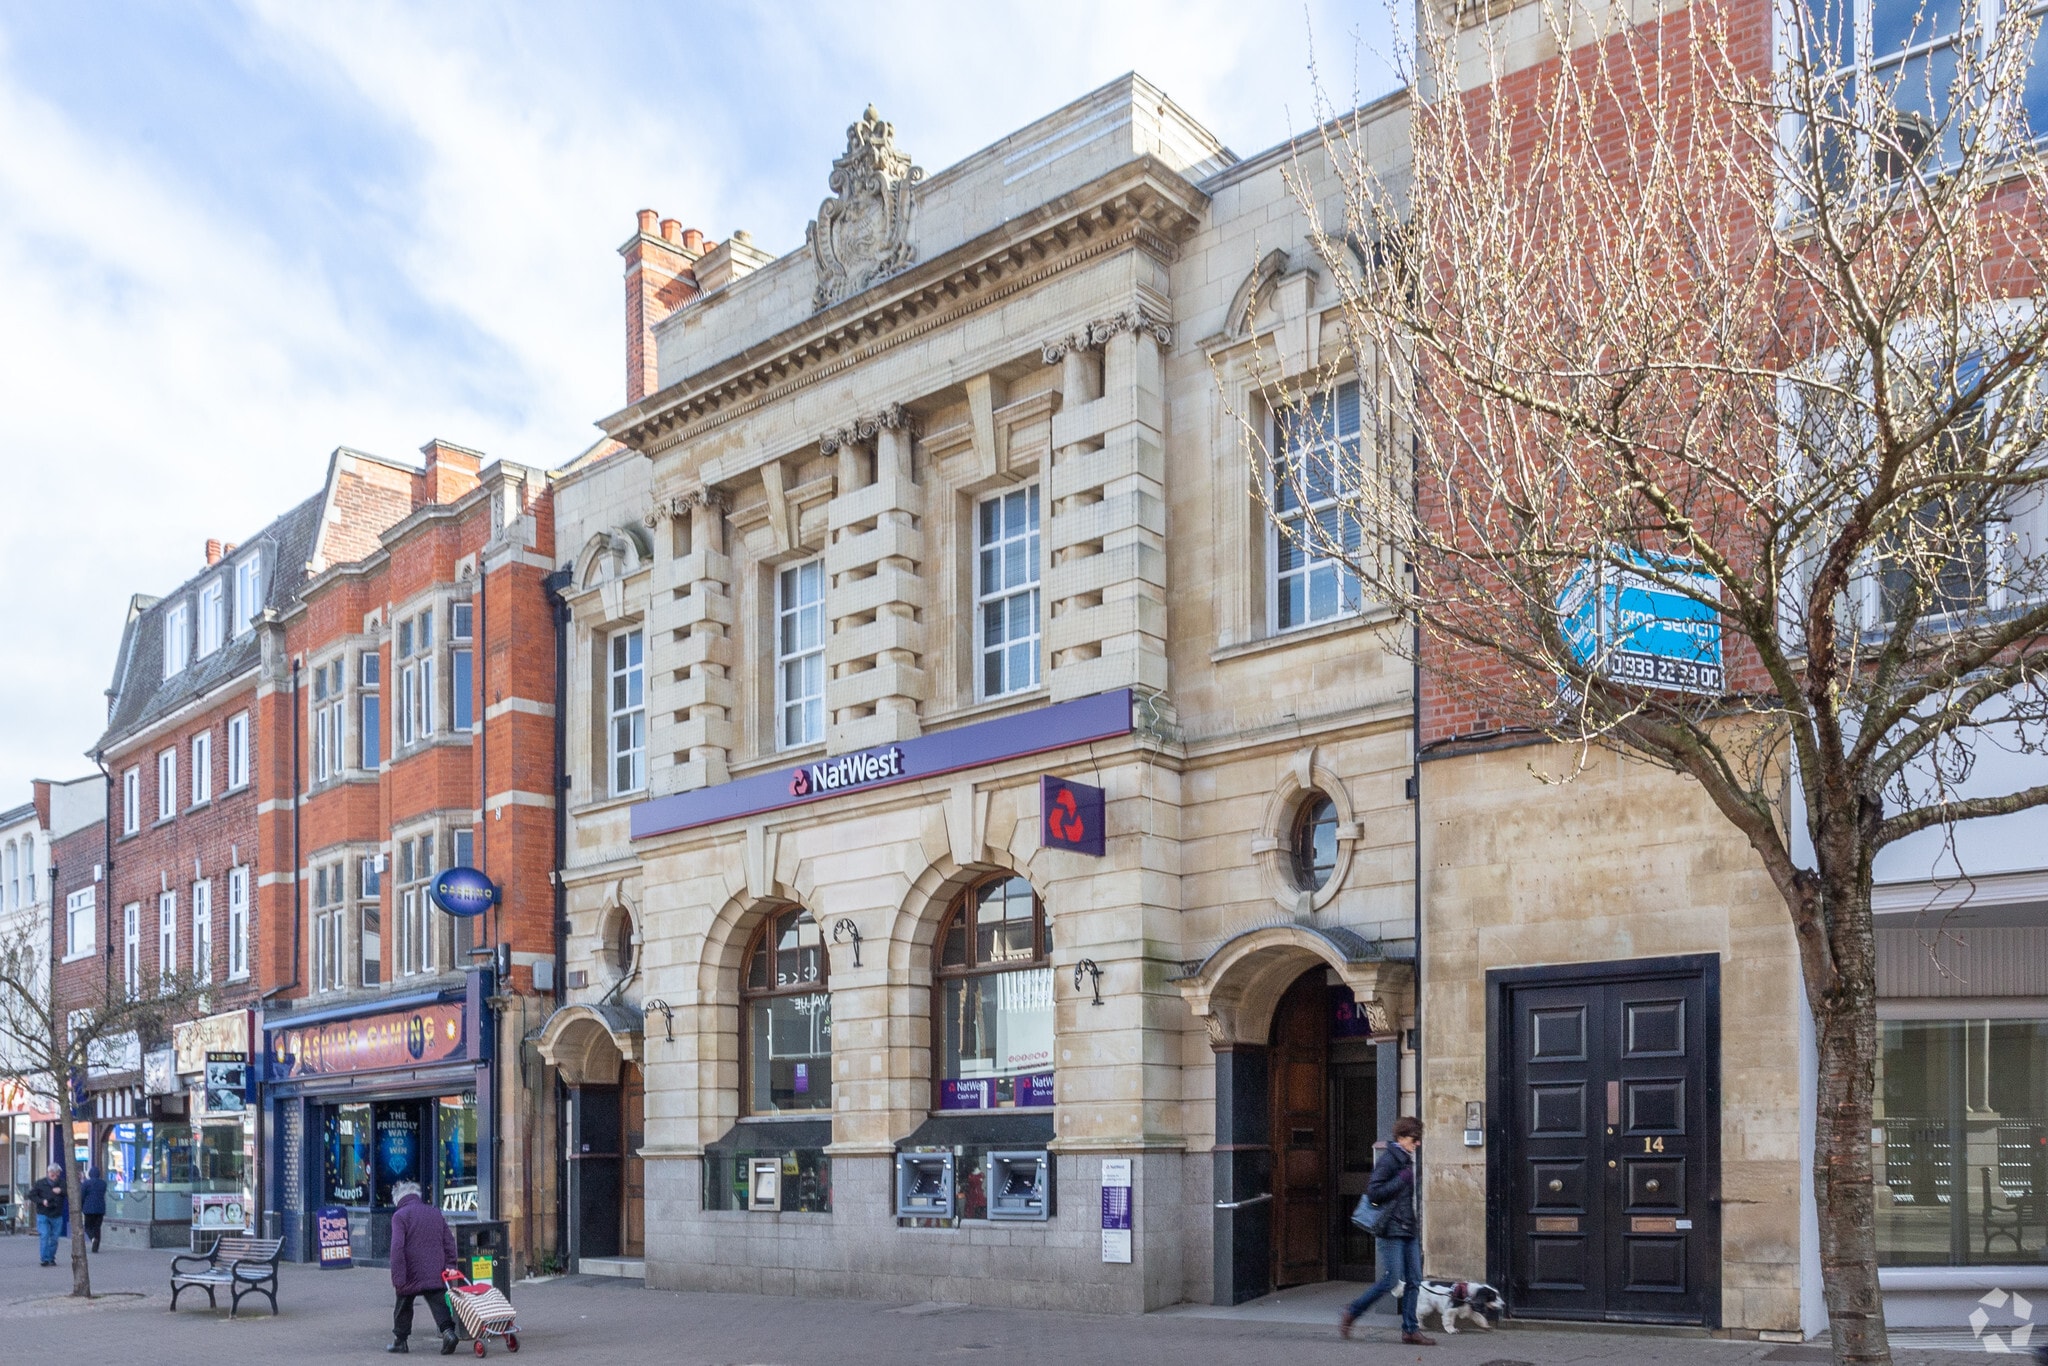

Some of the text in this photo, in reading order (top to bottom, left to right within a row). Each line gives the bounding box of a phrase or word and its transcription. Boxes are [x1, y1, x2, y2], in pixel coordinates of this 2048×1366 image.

[1612, 575, 1640, 589] FRST
[1612, 655, 1654, 679] 0933
[1656, 660, 1675, 682] 22
[812, 746, 899, 792] NatWest
[439, 883, 493, 899] CASHINO
[290, 1016, 434, 1062] CASHINO GAMING
[956, 1080, 986, 1092] NatWes
[957, 1092, 969, 1100] Cash
[389, 1111, 407, 1120] THE
[377, 1121, 418, 1130] FRIENDLY
[388, 1129, 408, 1138] WAY
[392, 1137, 404, 1146] TO
[1644, 1136, 1664, 1153] 14
[389, 1146, 407, 1155] WIN
[334, 1186, 363, 1200] JACKPOTS
[318, 1216, 347, 1230] Free
[319, 1228, 349, 1242] Cash
[323, 1246, 351, 1260] HERE
